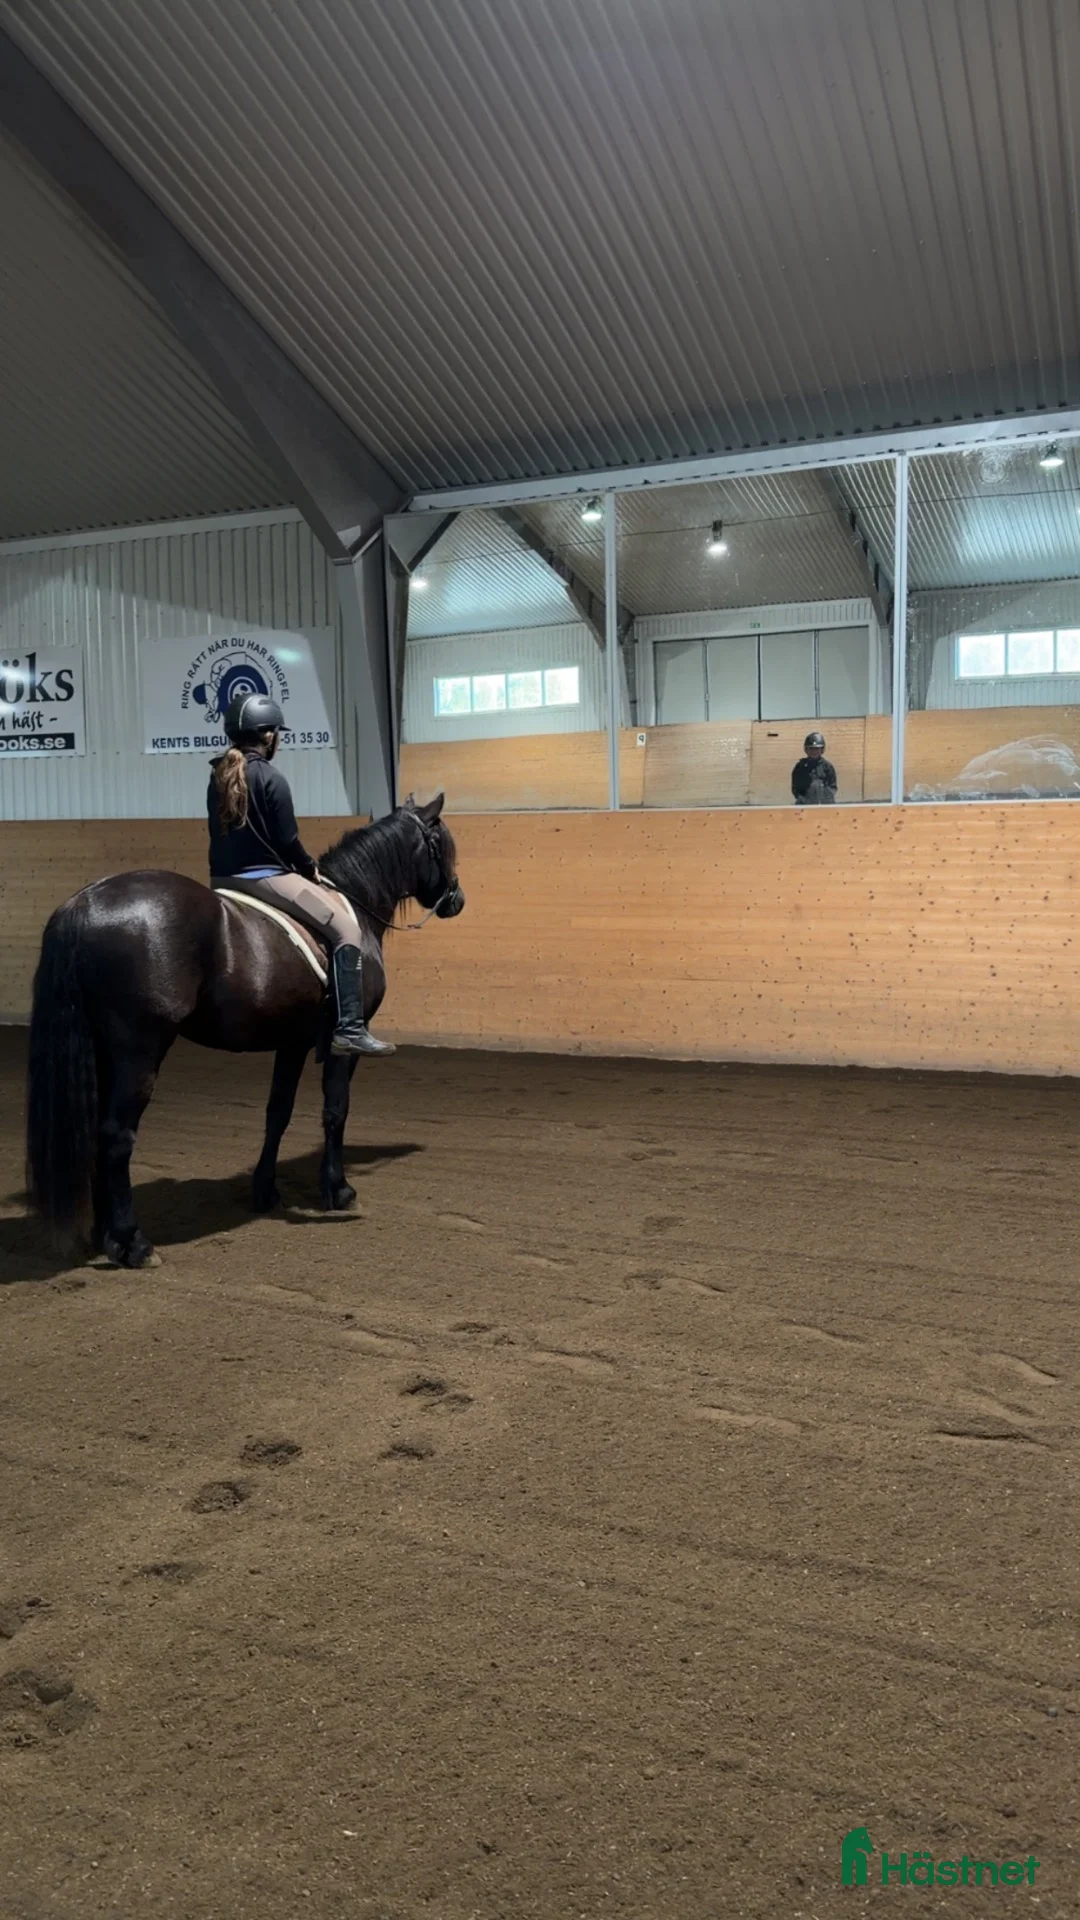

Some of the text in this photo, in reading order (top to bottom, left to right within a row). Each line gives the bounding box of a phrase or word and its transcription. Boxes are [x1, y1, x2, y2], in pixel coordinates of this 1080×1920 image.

[181, 680, 193, 709] RING
[230, 637, 246, 648] DU
[246, 640, 268, 659] HAR
[266, 655, 290, 704] RINGFEL
[152, 737, 190, 749] KENTS
[193, 736, 231, 748] BILGU
[299, 731, 314, 744] 35
[315, 731, 330, 743] 30
